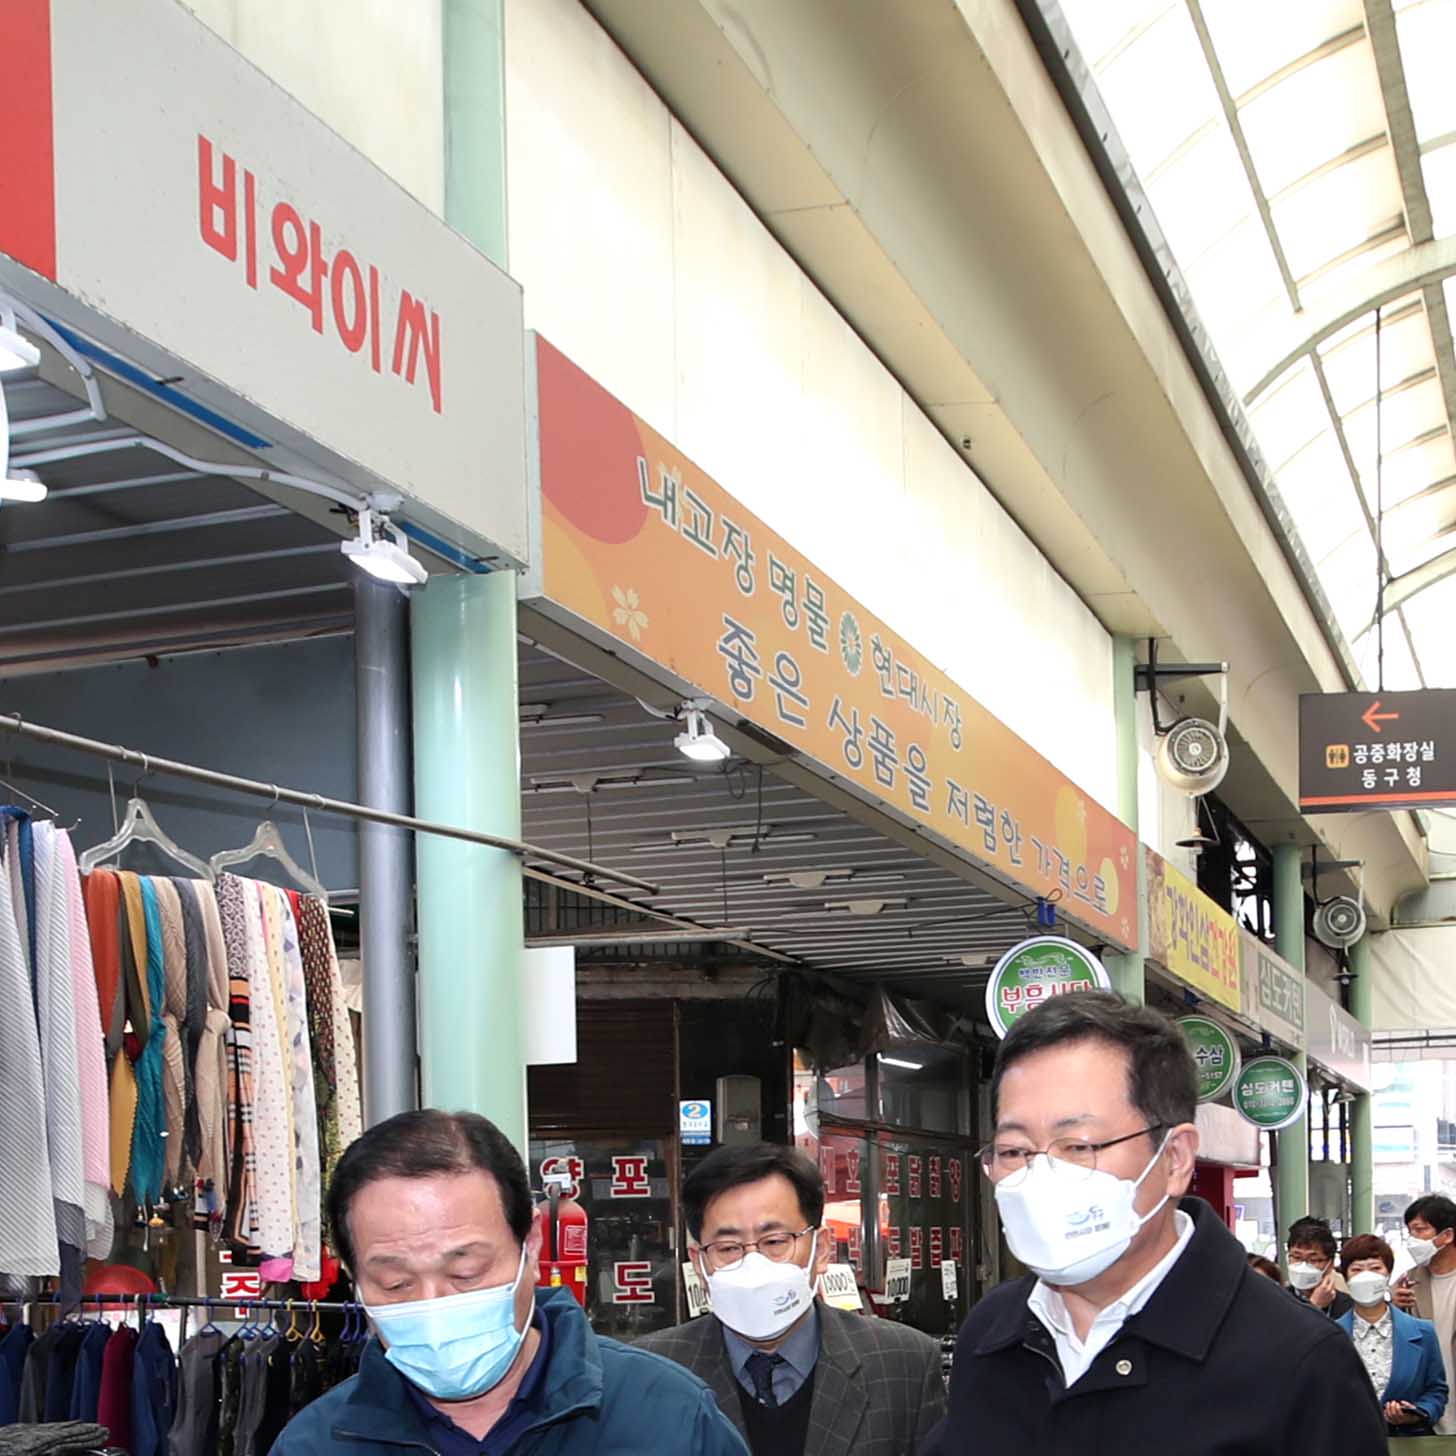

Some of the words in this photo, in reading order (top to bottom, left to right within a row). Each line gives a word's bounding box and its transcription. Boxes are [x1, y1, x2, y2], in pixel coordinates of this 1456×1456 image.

[197, 134, 442, 414] 비와이씨
[637, 456, 756, 594] 내고장
[767, 552, 830, 653] 명물
[871, 634, 964, 752] 현대시장
[717, 615, 811, 731] 좋은
[829, 697, 932, 813] 상품을
[946, 778, 1024, 866] 저렴한
[1031, 836, 1111, 917] 가격으로
[1352, 741, 1435, 766] 공중화장실
[1361, 767, 1422, 789] 동구청
[687, 1103, 703, 1120] 2
